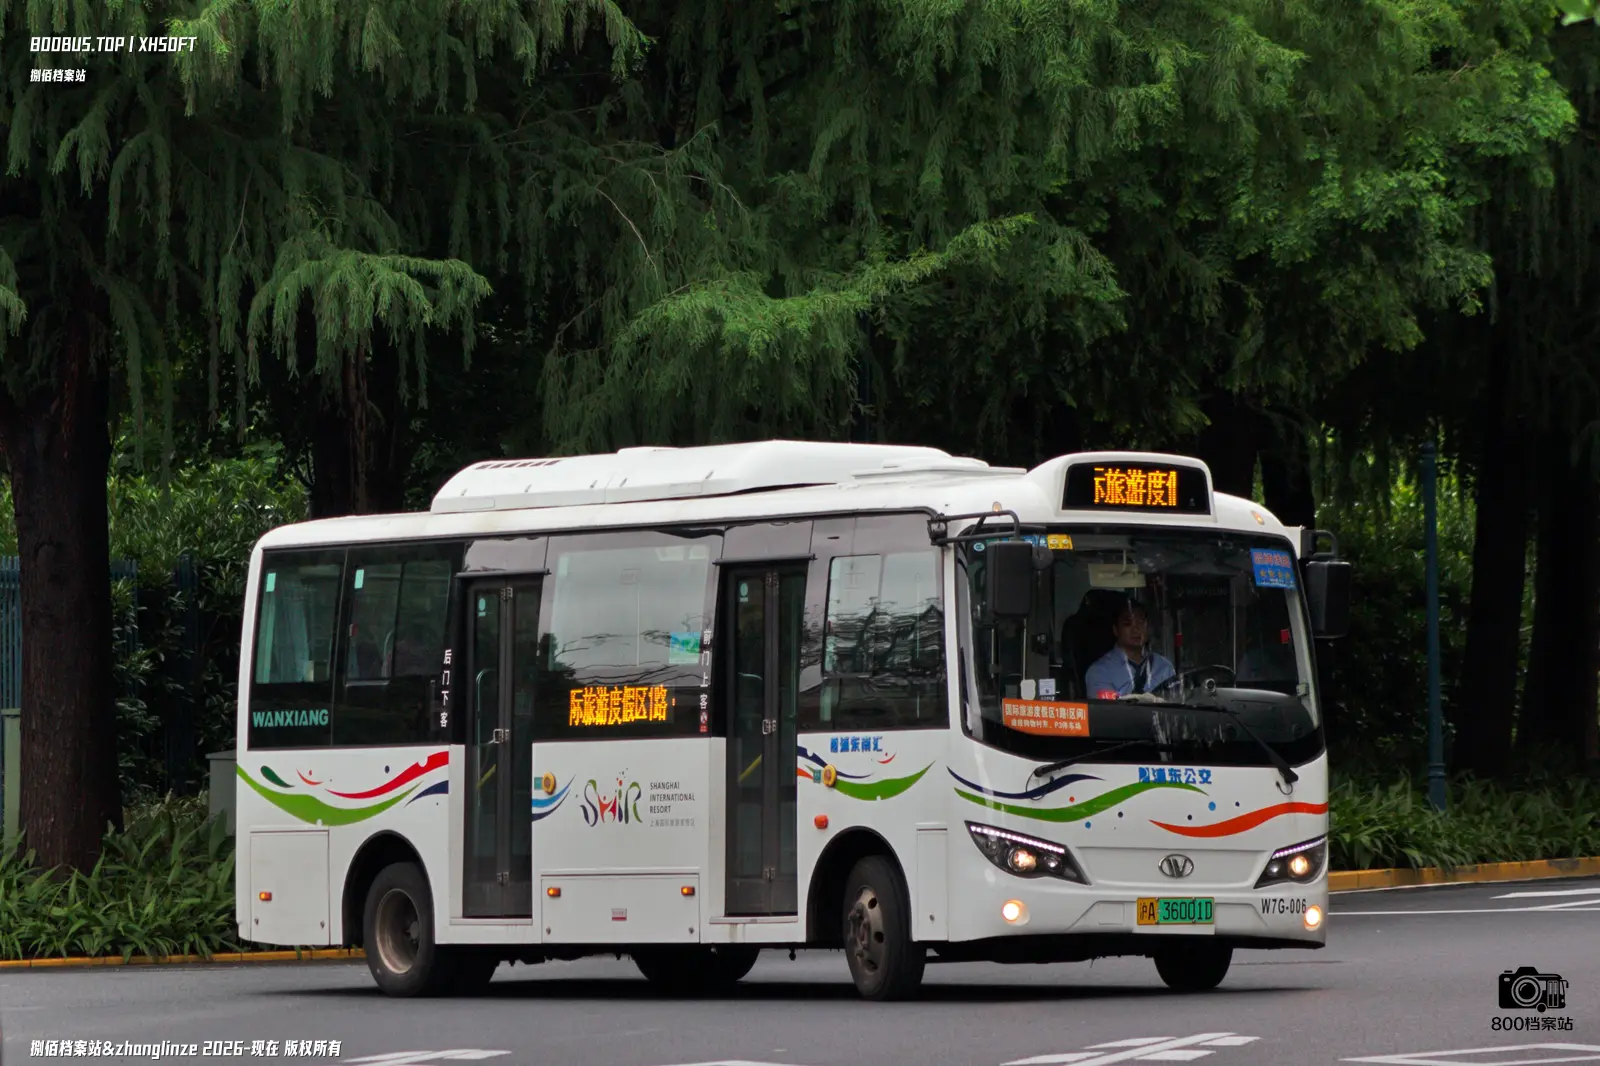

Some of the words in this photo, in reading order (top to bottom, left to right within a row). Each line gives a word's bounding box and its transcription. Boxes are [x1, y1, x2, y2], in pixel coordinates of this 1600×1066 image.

[440, 649, 452, 728] 后门下客
[252, 709, 329, 728] WANXIANG
[649, 781, 680, 790] SHANGHAI
[649, 793, 696, 802] INTERNATIONAL
[649, 805, 671, 814] RESORT
[1261, 898, 1307, 915] W7G-006
